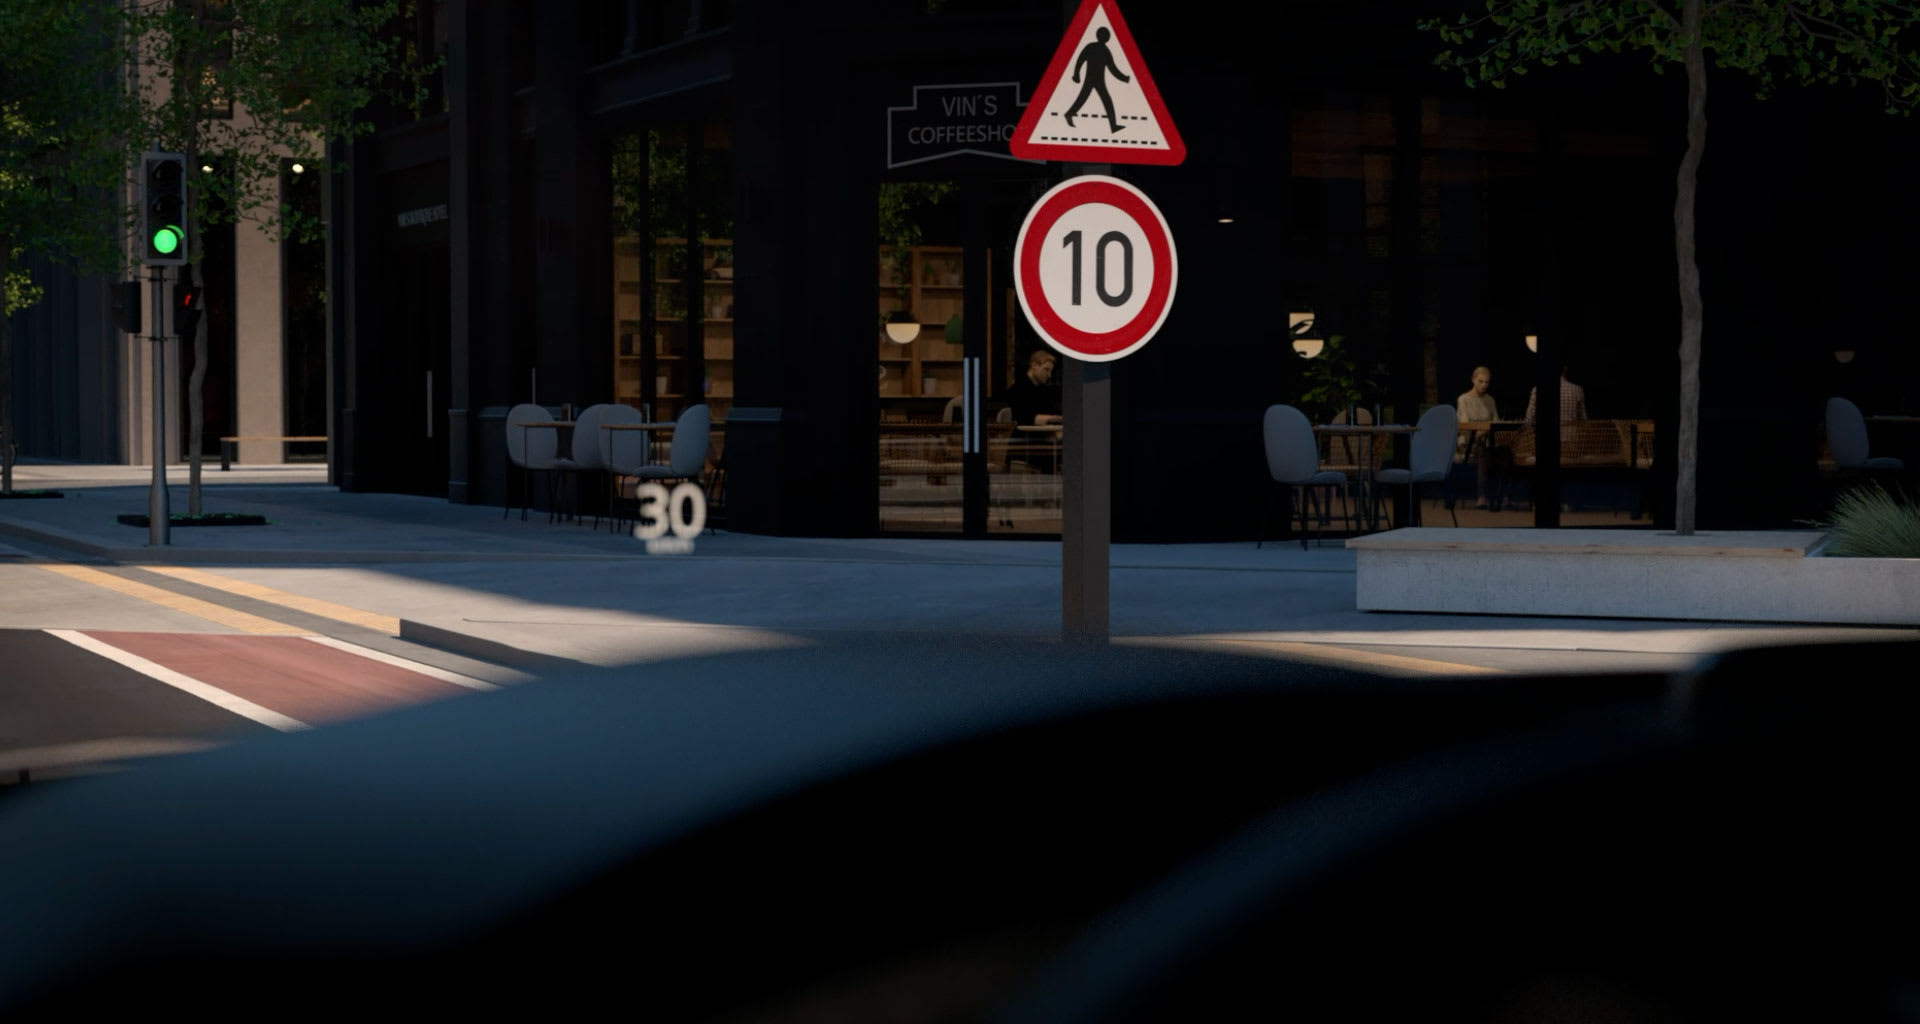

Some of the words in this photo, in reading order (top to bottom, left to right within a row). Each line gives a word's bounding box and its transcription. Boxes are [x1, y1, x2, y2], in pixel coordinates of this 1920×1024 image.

[908, 124, 1018, 145] COFFEESHO
[1063, 230, 1133, 307] 10
[633, 481, 707, 540] 30
